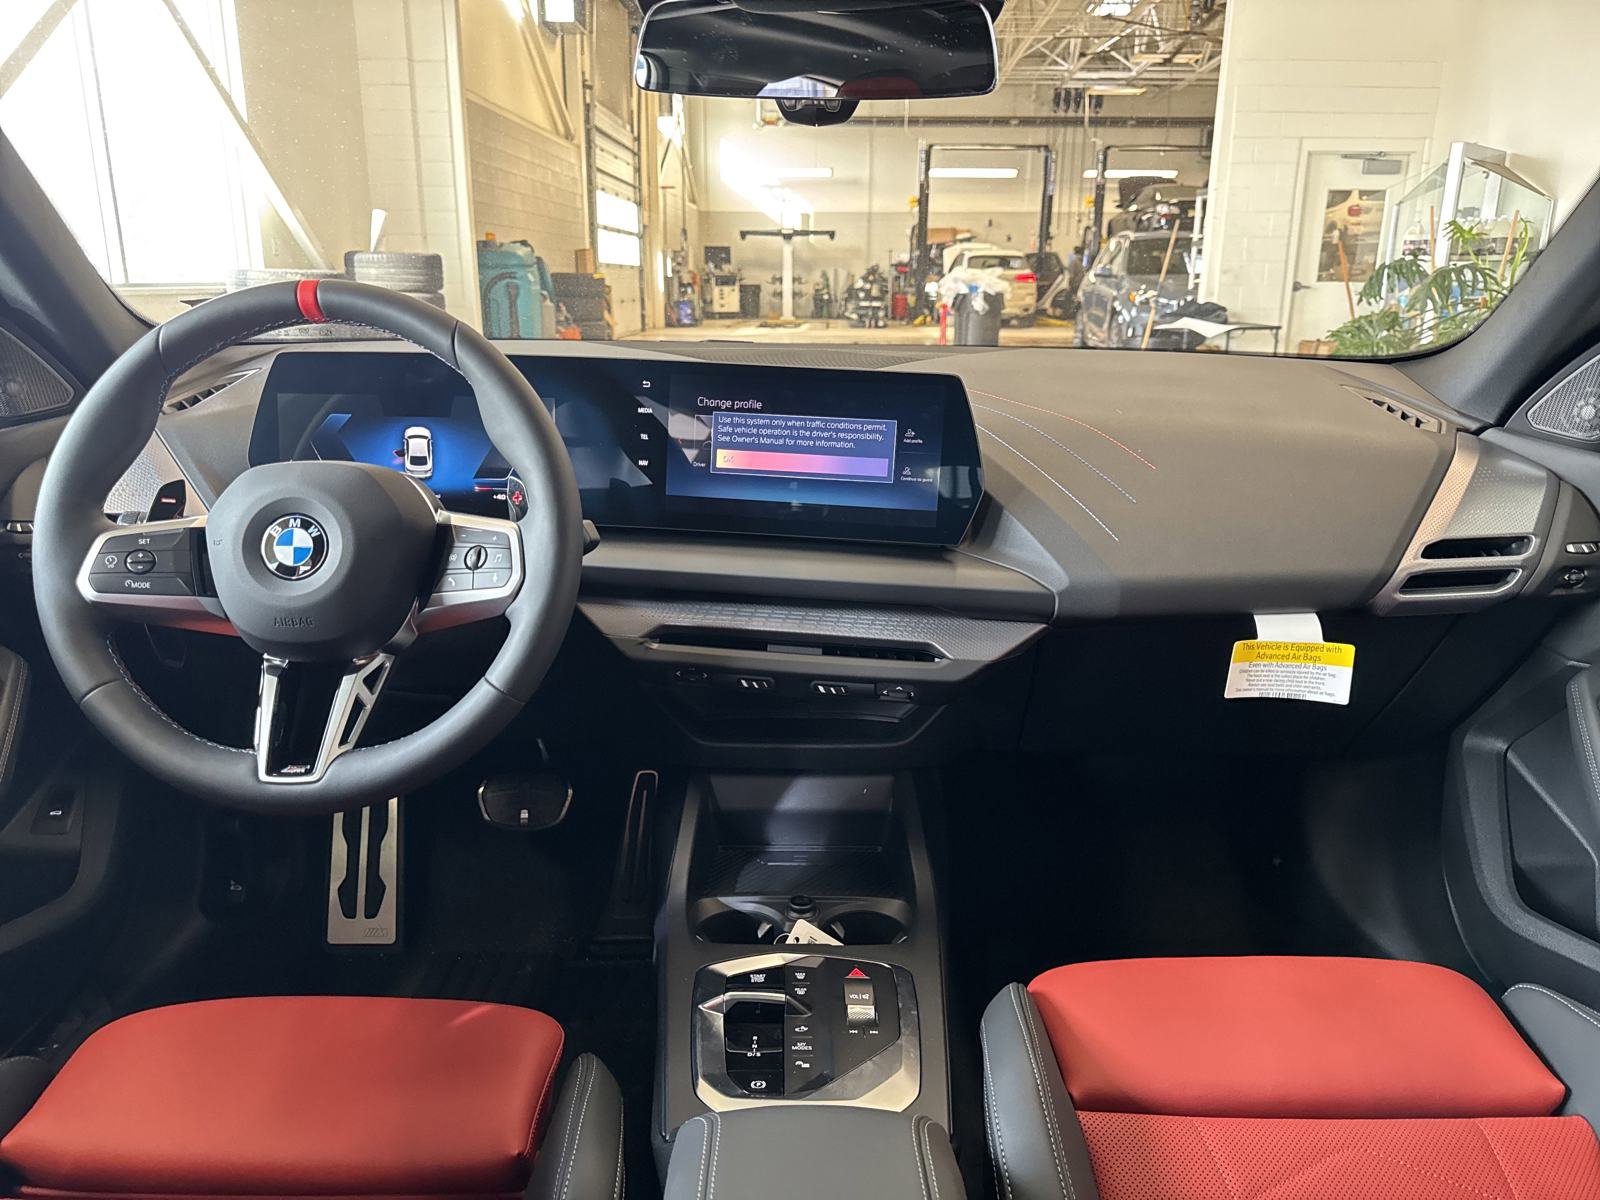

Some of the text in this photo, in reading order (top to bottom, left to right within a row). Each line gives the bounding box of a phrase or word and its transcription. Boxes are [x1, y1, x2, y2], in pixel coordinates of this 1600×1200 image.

[697, 396, 763, 410] Change profile
[718, 416, 731, 424] Use
[733, 416, 745, 425] this
[746, 417, 770, 426] system
[771, 418, 785, 427] only
[806, 420, 826, 428] traffic
[826, 422, 862, 430] conditions
[733, 426, 758, 435] vehicle
[758, 428, 791, 437] operation
[811, 430, 837, 438] driver's
[837, 432, 885, 441] responsibility.
[731, 435, 759, 444] Owner's
[760, 437, 785, 445] Manual
[785, 438, 795, 446] for
[815, 440, 856, 449] information.
[131, 581, 151, 589] MODE
[273, 617, 315, 628] AIRBAG
[1242, 643, 1256, 651] This
[1256, 643, 1281, 651] Vehicle
[1290, 644, 1325, 653] Equipped
[1326, 646, 1342, 654] with
[1255, 652, 1291, 660] Advanced
[1303, 653, 1322, 662] Bags
[1312, 664, 1328, 672] Bags
